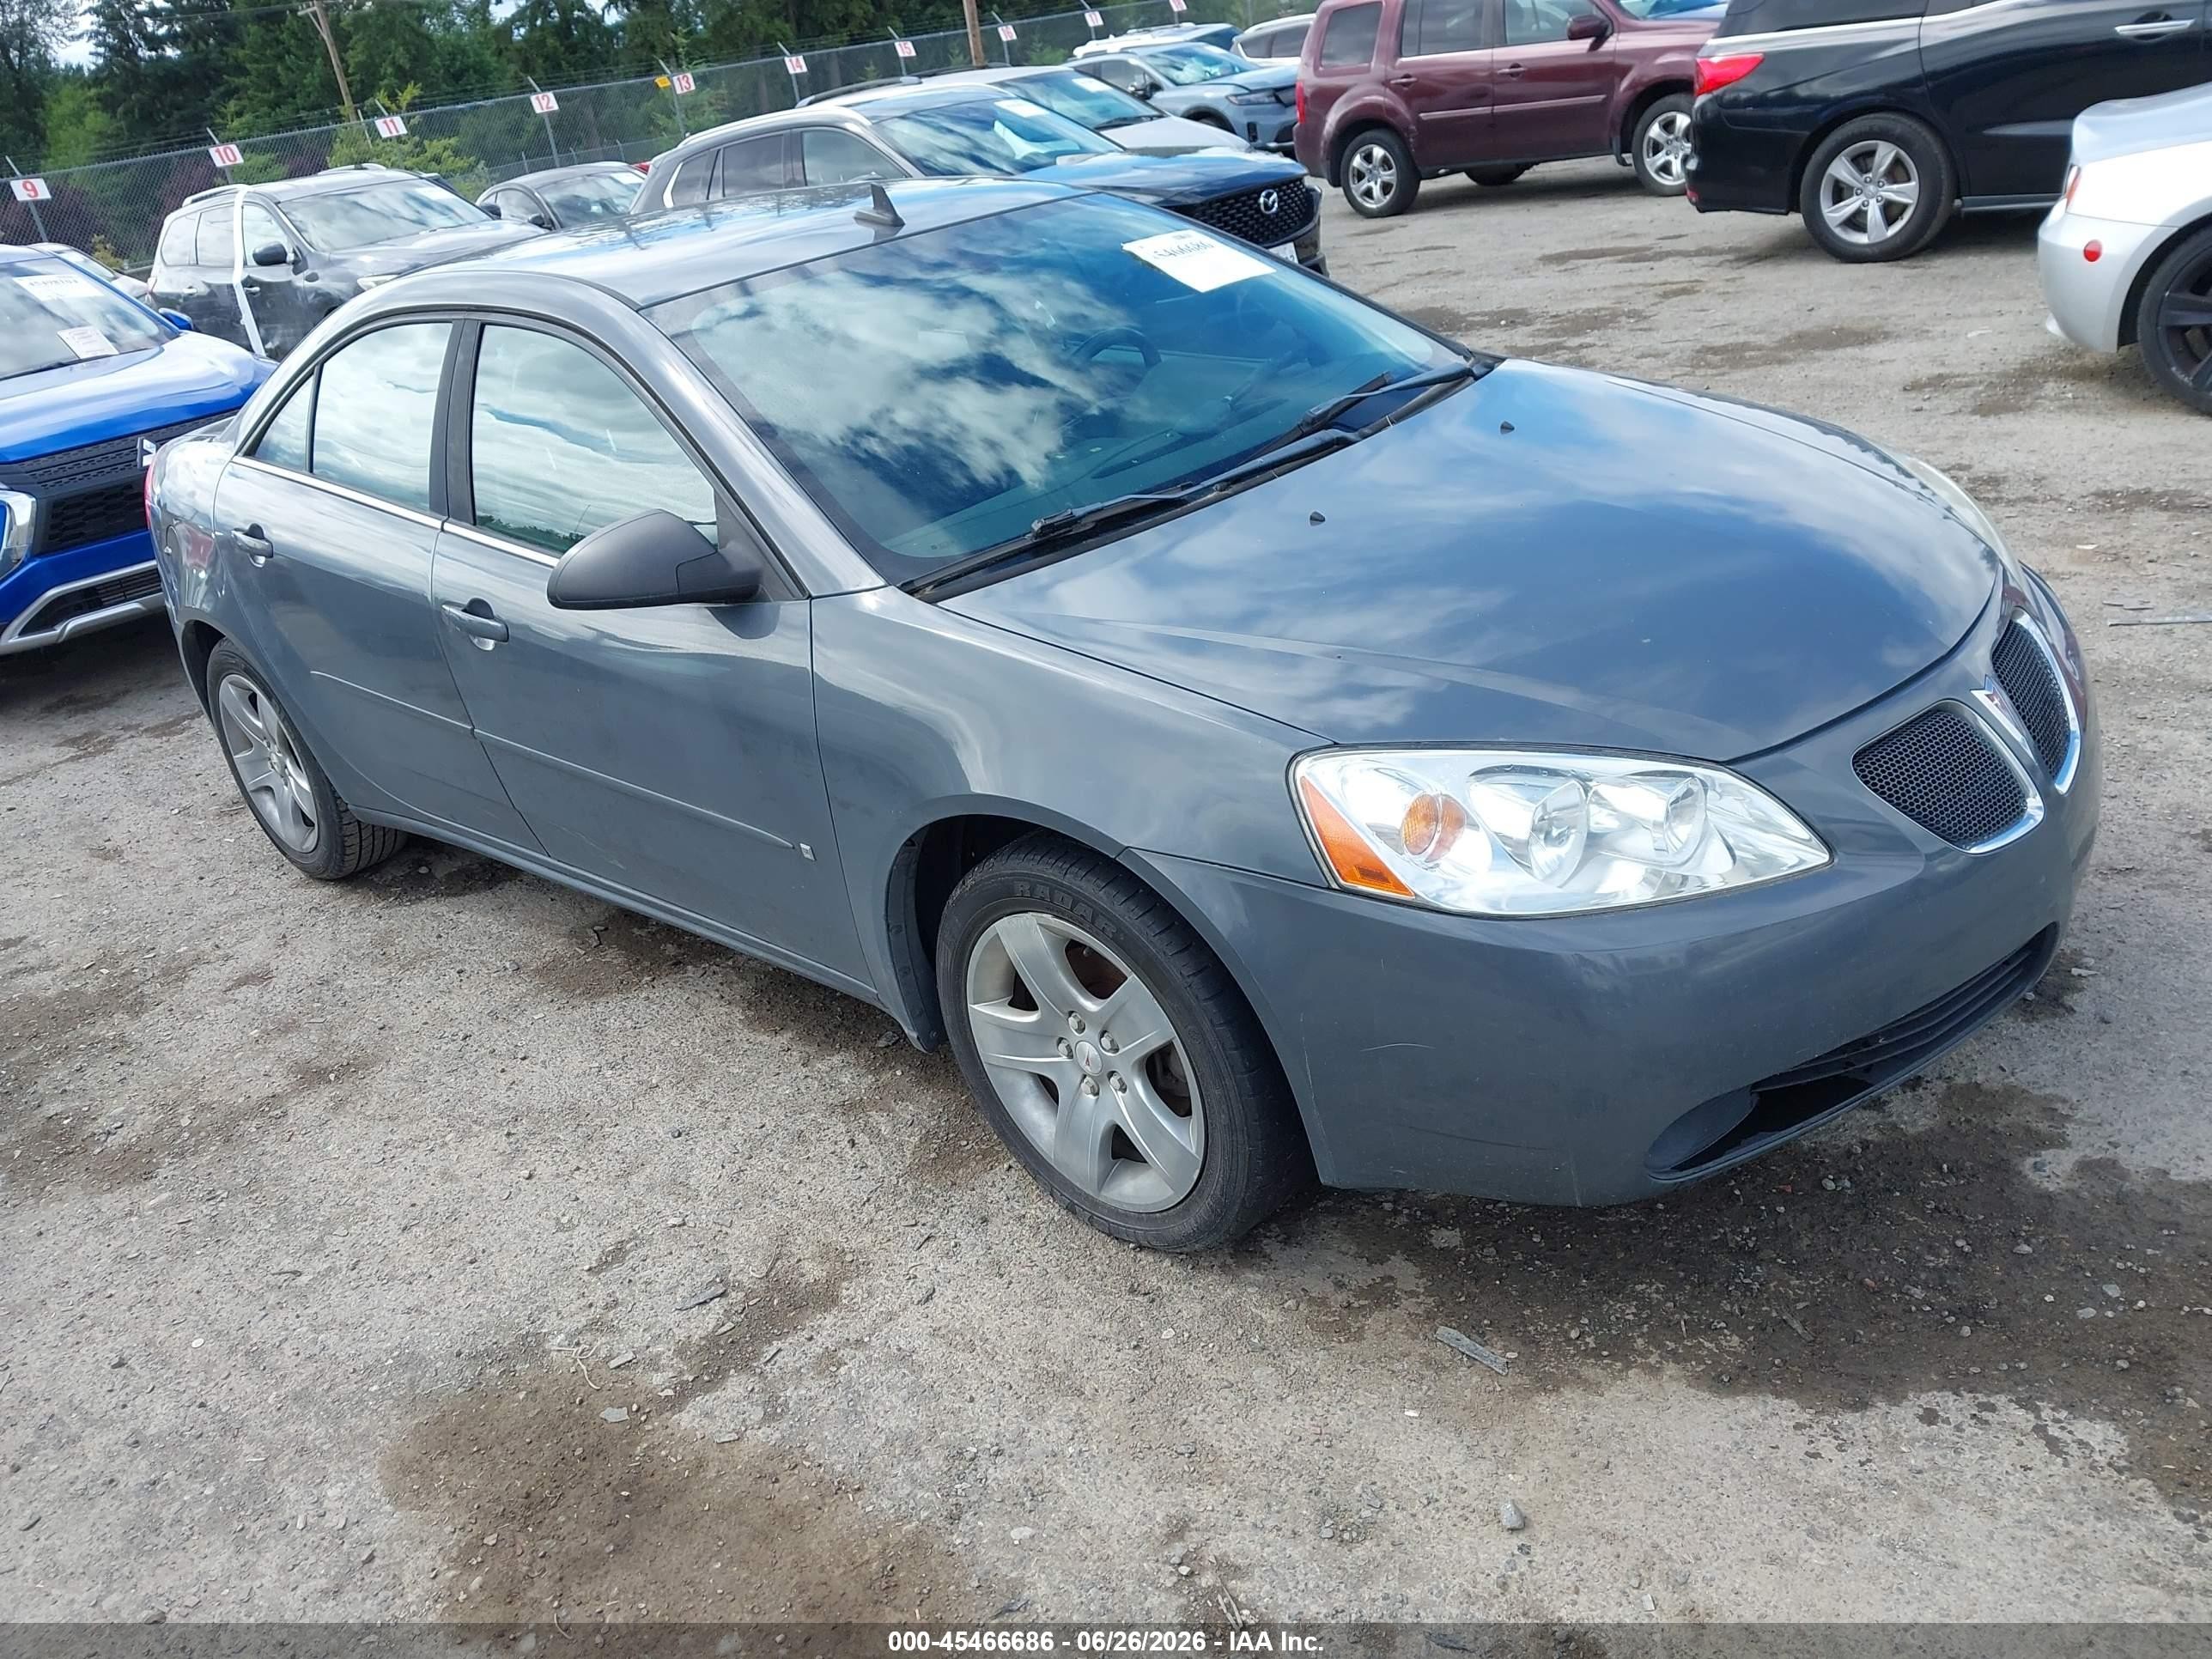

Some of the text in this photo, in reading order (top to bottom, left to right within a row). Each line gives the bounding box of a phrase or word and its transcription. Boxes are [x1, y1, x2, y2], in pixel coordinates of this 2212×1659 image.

[898, 41, 912, 56] 15
[789, 58, 803, 71] 14
[677, 74, 691, 91] 13
[535, 94, 554, 112] 12
[383, 118, 399, 135] 11
[216, 145, 237, 165] 10
[22, 180, 39, 198] 9
[1013, 881, 1117, 938] RADAR
